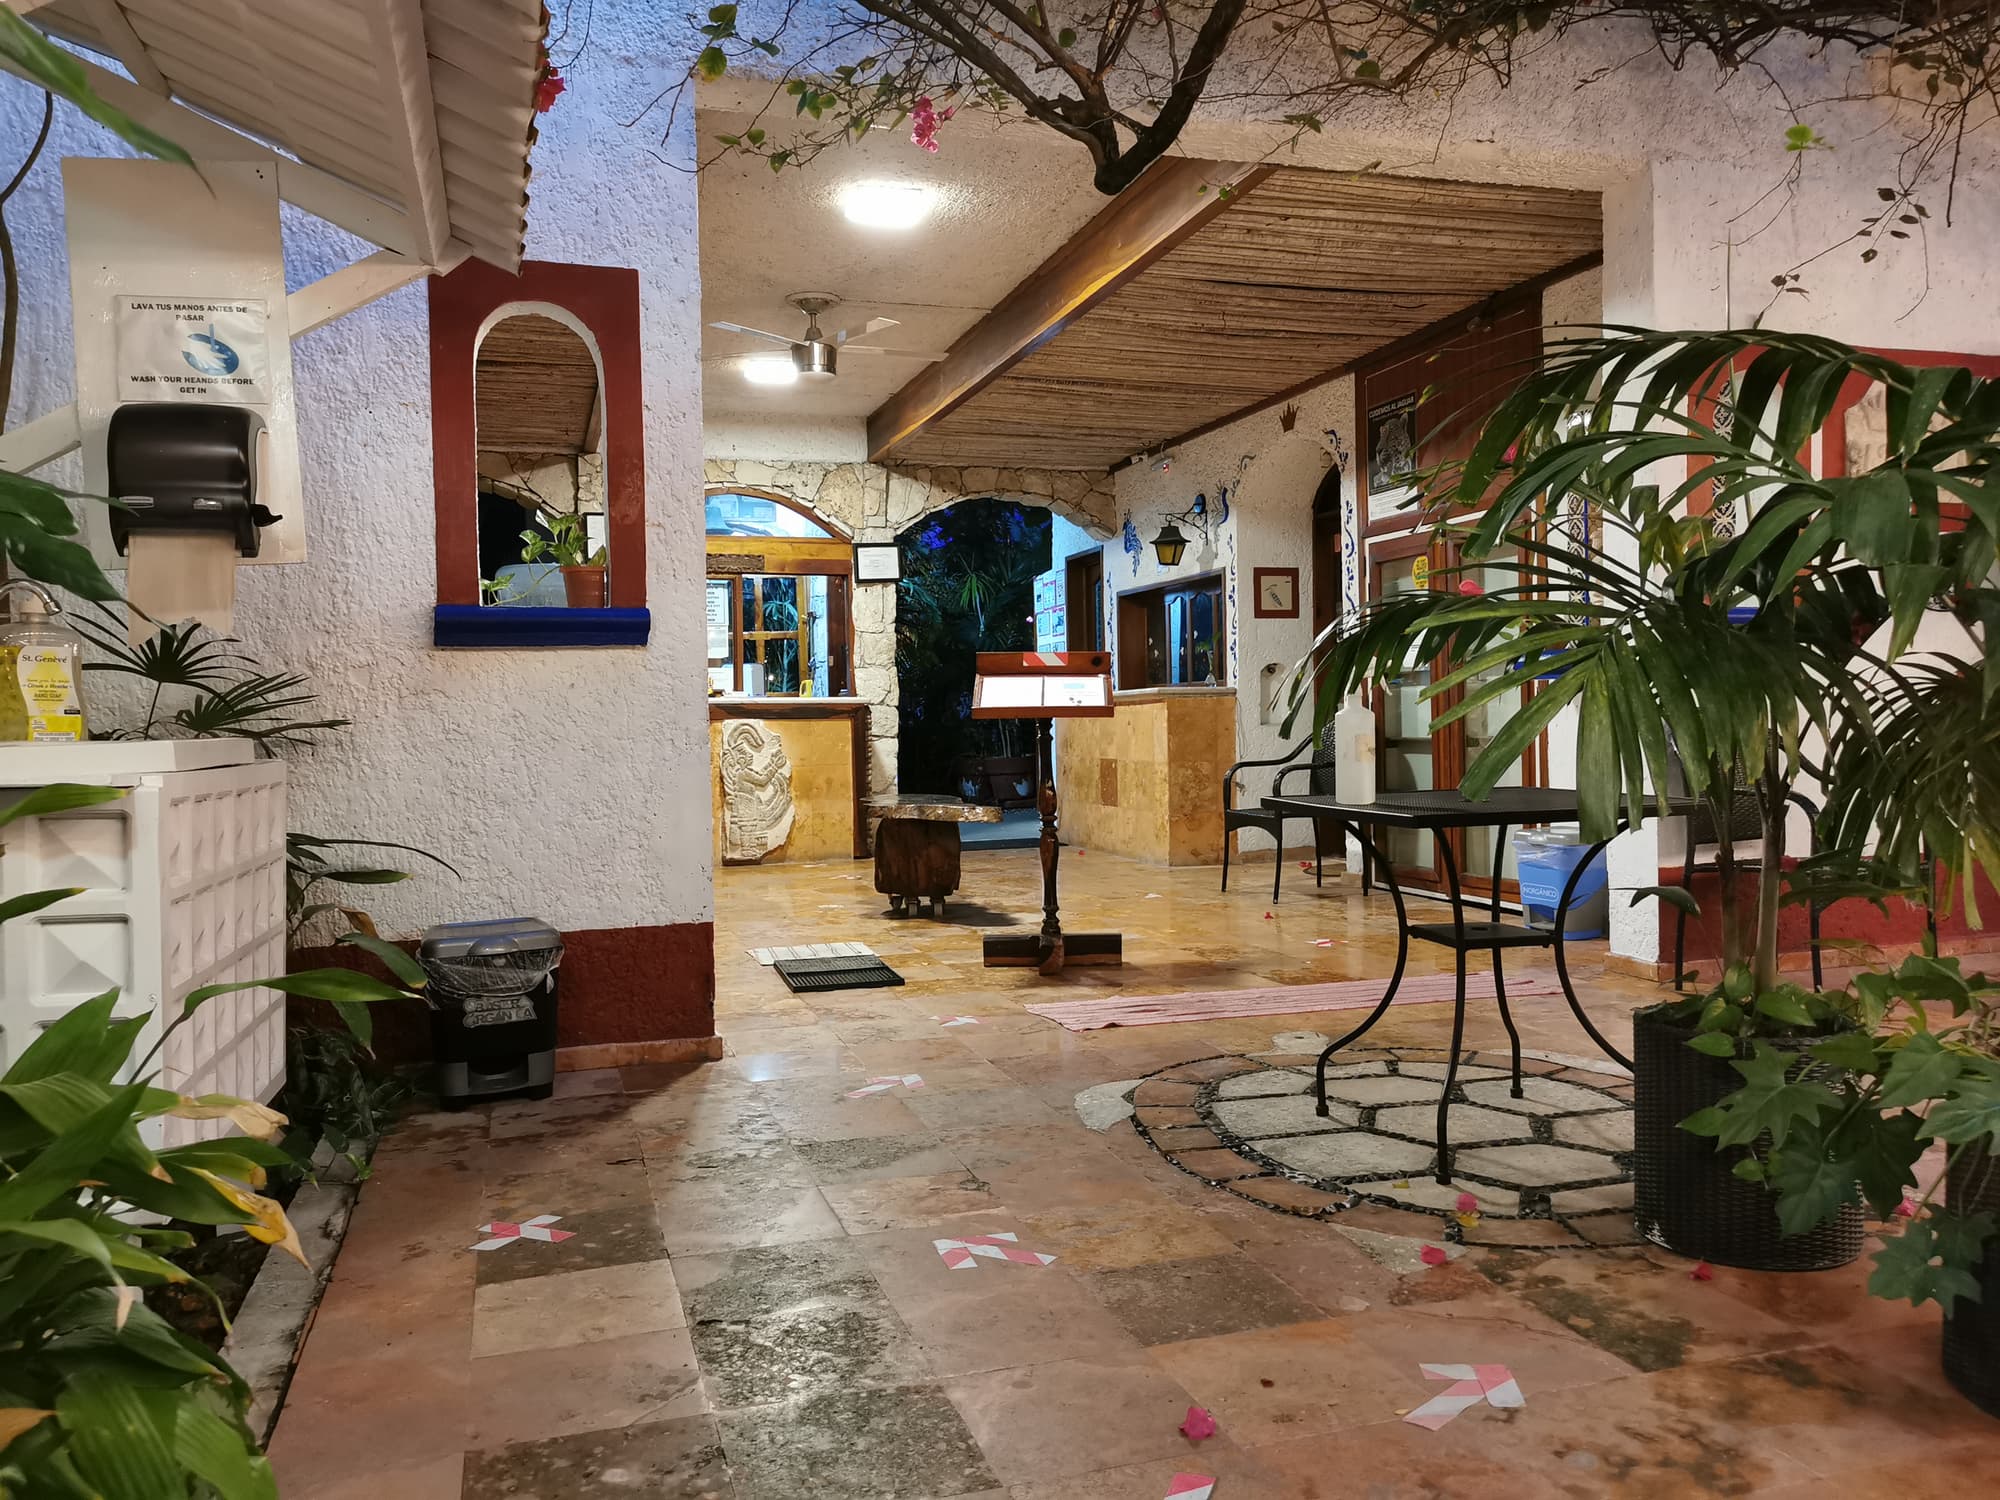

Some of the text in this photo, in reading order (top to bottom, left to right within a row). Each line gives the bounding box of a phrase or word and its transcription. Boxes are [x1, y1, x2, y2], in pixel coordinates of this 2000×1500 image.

[155, 303, 172, 311] TUS
[174, 304, 205, 312] MANOS
[207, 305, 234, 313] ANTES
[176, 314, 205, 322] PASAR
[220, 377, 254, 385] BEFORE
